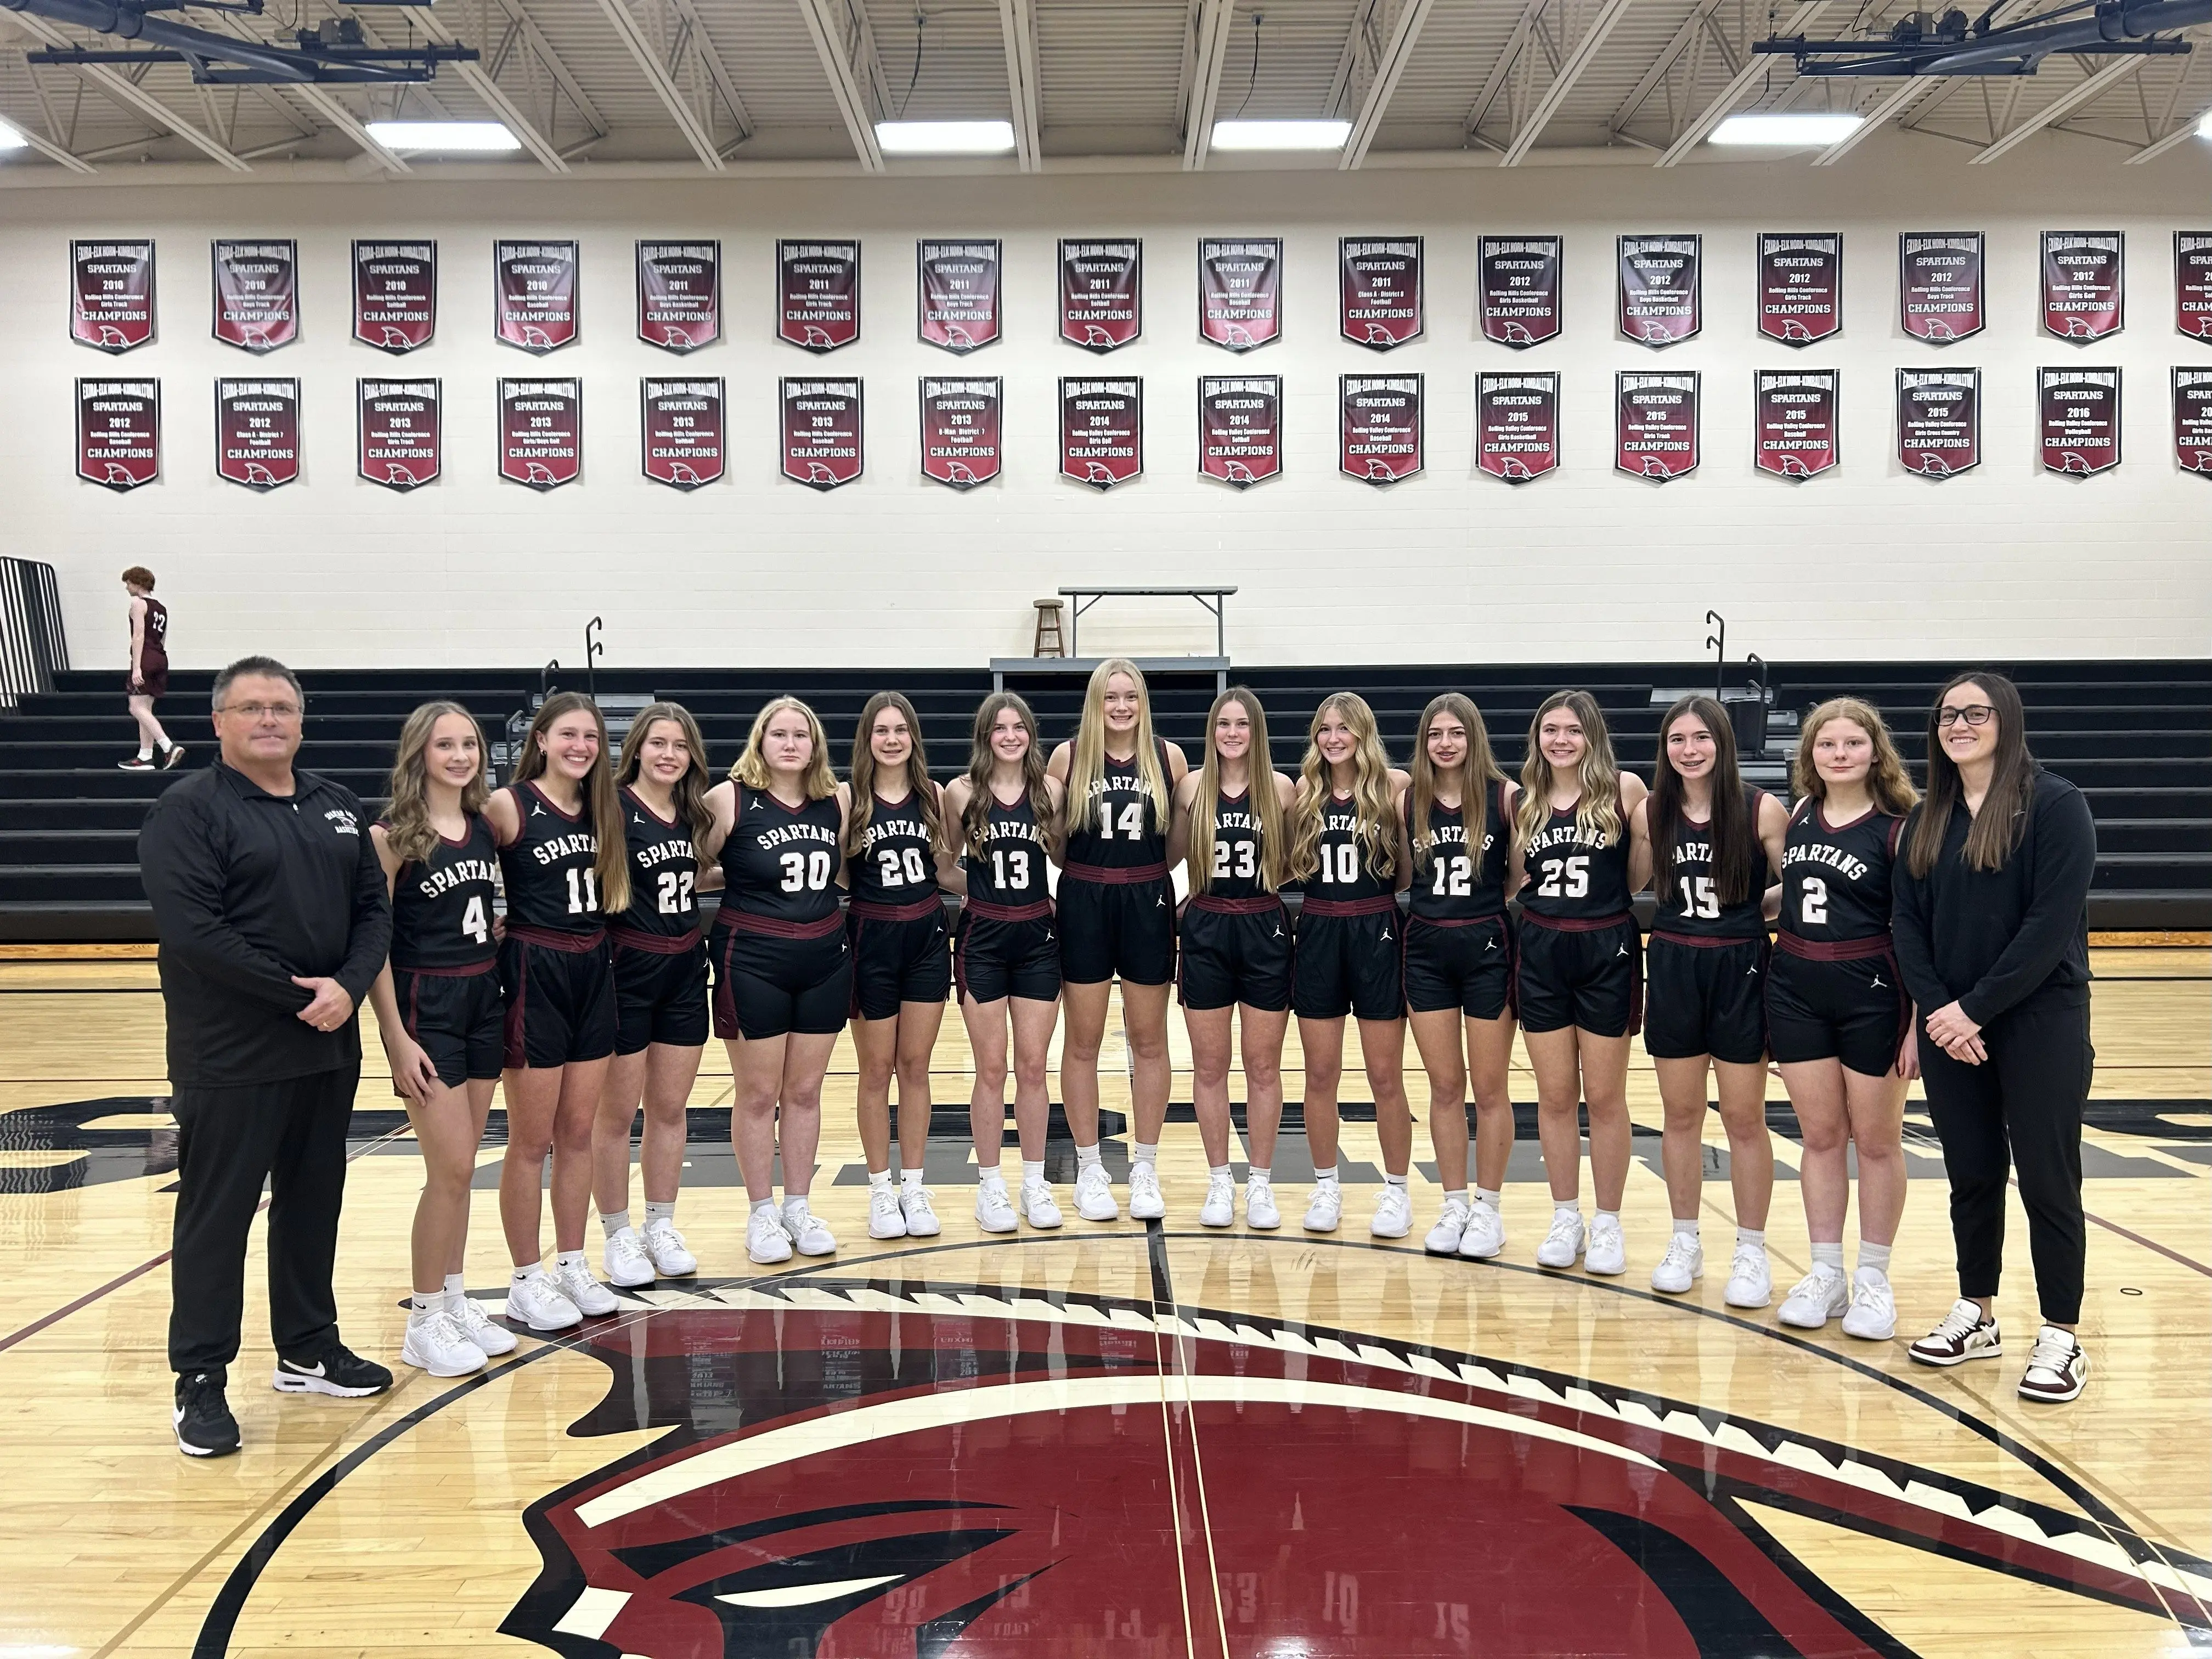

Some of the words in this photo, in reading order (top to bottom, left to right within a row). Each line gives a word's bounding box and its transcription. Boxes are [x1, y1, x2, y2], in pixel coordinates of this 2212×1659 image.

[1916, 257, 1965, 266] SPARTANS
[2058, 256, 2107, 264] SPARTANS
[88, 264, 136, 273] SPARTANS
[230, 264, 279, 273] SPARTANS
[370, 265, 419, 274] SPARTANS
[512, 265, 560, 273] SPARTANS
[653, 265, 702, 273] SPARTANS
[794, 264, 842, 273] SPARTANS
[935, 264, 983, 273] SPARTANS
[1075, 263, 1124, 272] SPARTANS
[1215, 263, 1265, 272] SPARTANS
[1650, 275, 1671, 285] 2012
[1790, 274, 1810, 283] 2012
[1932, 273, 1951, 281] 2012
[2073, 272, 2094, 280] 2012
[103, 280, 123, 290] 2010
[245, 280, 266, 290] 2010
[386, 281, 406, 290] 2010
[527, 281, 547, 290] 2010
[669, 281, 687, 290] 2011
[810, 280, 828, 289] 2011
[950, 279, 969, 290] 2011
[1091, 279, 1109, 289] 2011
[1231, 279, 1250, 288] 2011
[1373, 278, 1390, 287] 2011
[1510, 276, 1530, 286] 2012
[1627, 307, 1691, 315] CHAMPIONS
[1765, 304, 1830, 313] CHAMPIONS
[1908, 303, 1973, 312] CHAMPIONS
[2050, 302, 2114, 311] CHAMPIONS
[82, 312, 146, 320] CHAMPIONS
[223, 311, 289, 320] CHAMPIONS
[647, 312, 712, 320] CHAMPIONS
[787, 311, 850, 320] CHAMPIONS
[928, 311, 991, 320] CHAMPIONS
[1068, 311, 1132, 319] CHAMPIONS
[1208, 309, 1272, 318] CHAMPIONS
[1349, 309, 1413, 318] CHAMPIONS
[1486, 307, 1551, 316] CHAMPIONS
[364, 312, 428, 321] CHAMPIONS
[505, 312, 570, 321] CHAMPIONS
[1771, 394, 1820, 403] SPARTANS
[1912, 392, 1962, 400] SPARTANS
[2054, 391, 2103, 399] SPARTANS
[1076, 400, 1124, 409] SPARTANS
[1215, 400, 1263, 409] SPARTANS
[1357, 398, 1405, 407] SPARTANS
[1493, 397, 1542, 405] SPARTANS
[1633, 396, 1681, 404] SPARTANS
[93, 402, 142, 411] SPARTANS
[233, 402, 283, 411] SPARTANS
[375, 403, 424, 411] SPARTANS
[515, 402, 563, 410] SPARTANS
[658, 402, 707, 410] SPARTANS
[797, 402, 845, 410] SPARTANS
[936, 401, 985, 409] SPARTANS
[1508, 413, 1528, 421] 2015
[1646, 411, 1666, 420] 2015
[1786, 410, 1806, 419] 2015
[1928, 408, 1948, 417] 2015
[2068, 408, 2090, 417] 2016
[109, 418, 130, 427] 2012
[250, 418, 270, 427] 2012
[390, 418, 410, 427] 2013
[531, 417, 551, 427] 2013
[673, 417, 694, 427] 2013
[812, 416, 832, 426] 2013
[951, 415, 972, 425] 2013
[1090, 416, 1109, 426] 2014
[1230, 415, 1249, 425] 2014
[1371, 414, 1390, 423] 2014
[1624, 442, 1689, 450] CHAMPIONS
[1763, 441, 1828, 449] CHAMPIONS
[1905, 439, 1970, 448] CHAMPIONS
[2046, 438, 2111, 446] CHAMPIONS
[653, 448, 717, 456] CHAMPIONS
[791, 448, 855, 456] CHAMPIONS
[930, 448, 994, 456] CHAMPIONS
[1069, 448, 1133, 456] CHAMPIONS
[1209, 446, 1273, 455] CHAMPIONS
[1349, 444, 1414, 453] CHAMPIONS
[1485, 443, 1550, 452] CHAMPIONS
[88, 449, 153, 458] CHAMPIONS
[228, 449, 293, 458] CHAMPIONS
[369, 449, 433, 458] CHAMPIONS
[509, 448, 573, 457] CHAMPIONS
[1100, 802, 1142, 840] 14
[757, 824, 836, 850] SPARTANS
[637, 840, 698, 868] SPARTA
[1212, 840, 1255, 878] 23
[1321, 844, 1358, 883] 10
[1782, 844, 1867, 881] SPARTANS
[780, 851, 830, 892] 30
[878, 848, 926, 886] 20
[992, 851, 1029, 889] 13
[1432, 856, 1471, 896] 12
[1538, 856, 1589, 898] 25
[566, 868, 597, 913] 11
[658, 871, 693, 913] 22
[1680, 876, 1720, 918] 15
[1802, 877, 1827, 924] 2
[463, 896, 487, 944] 4
